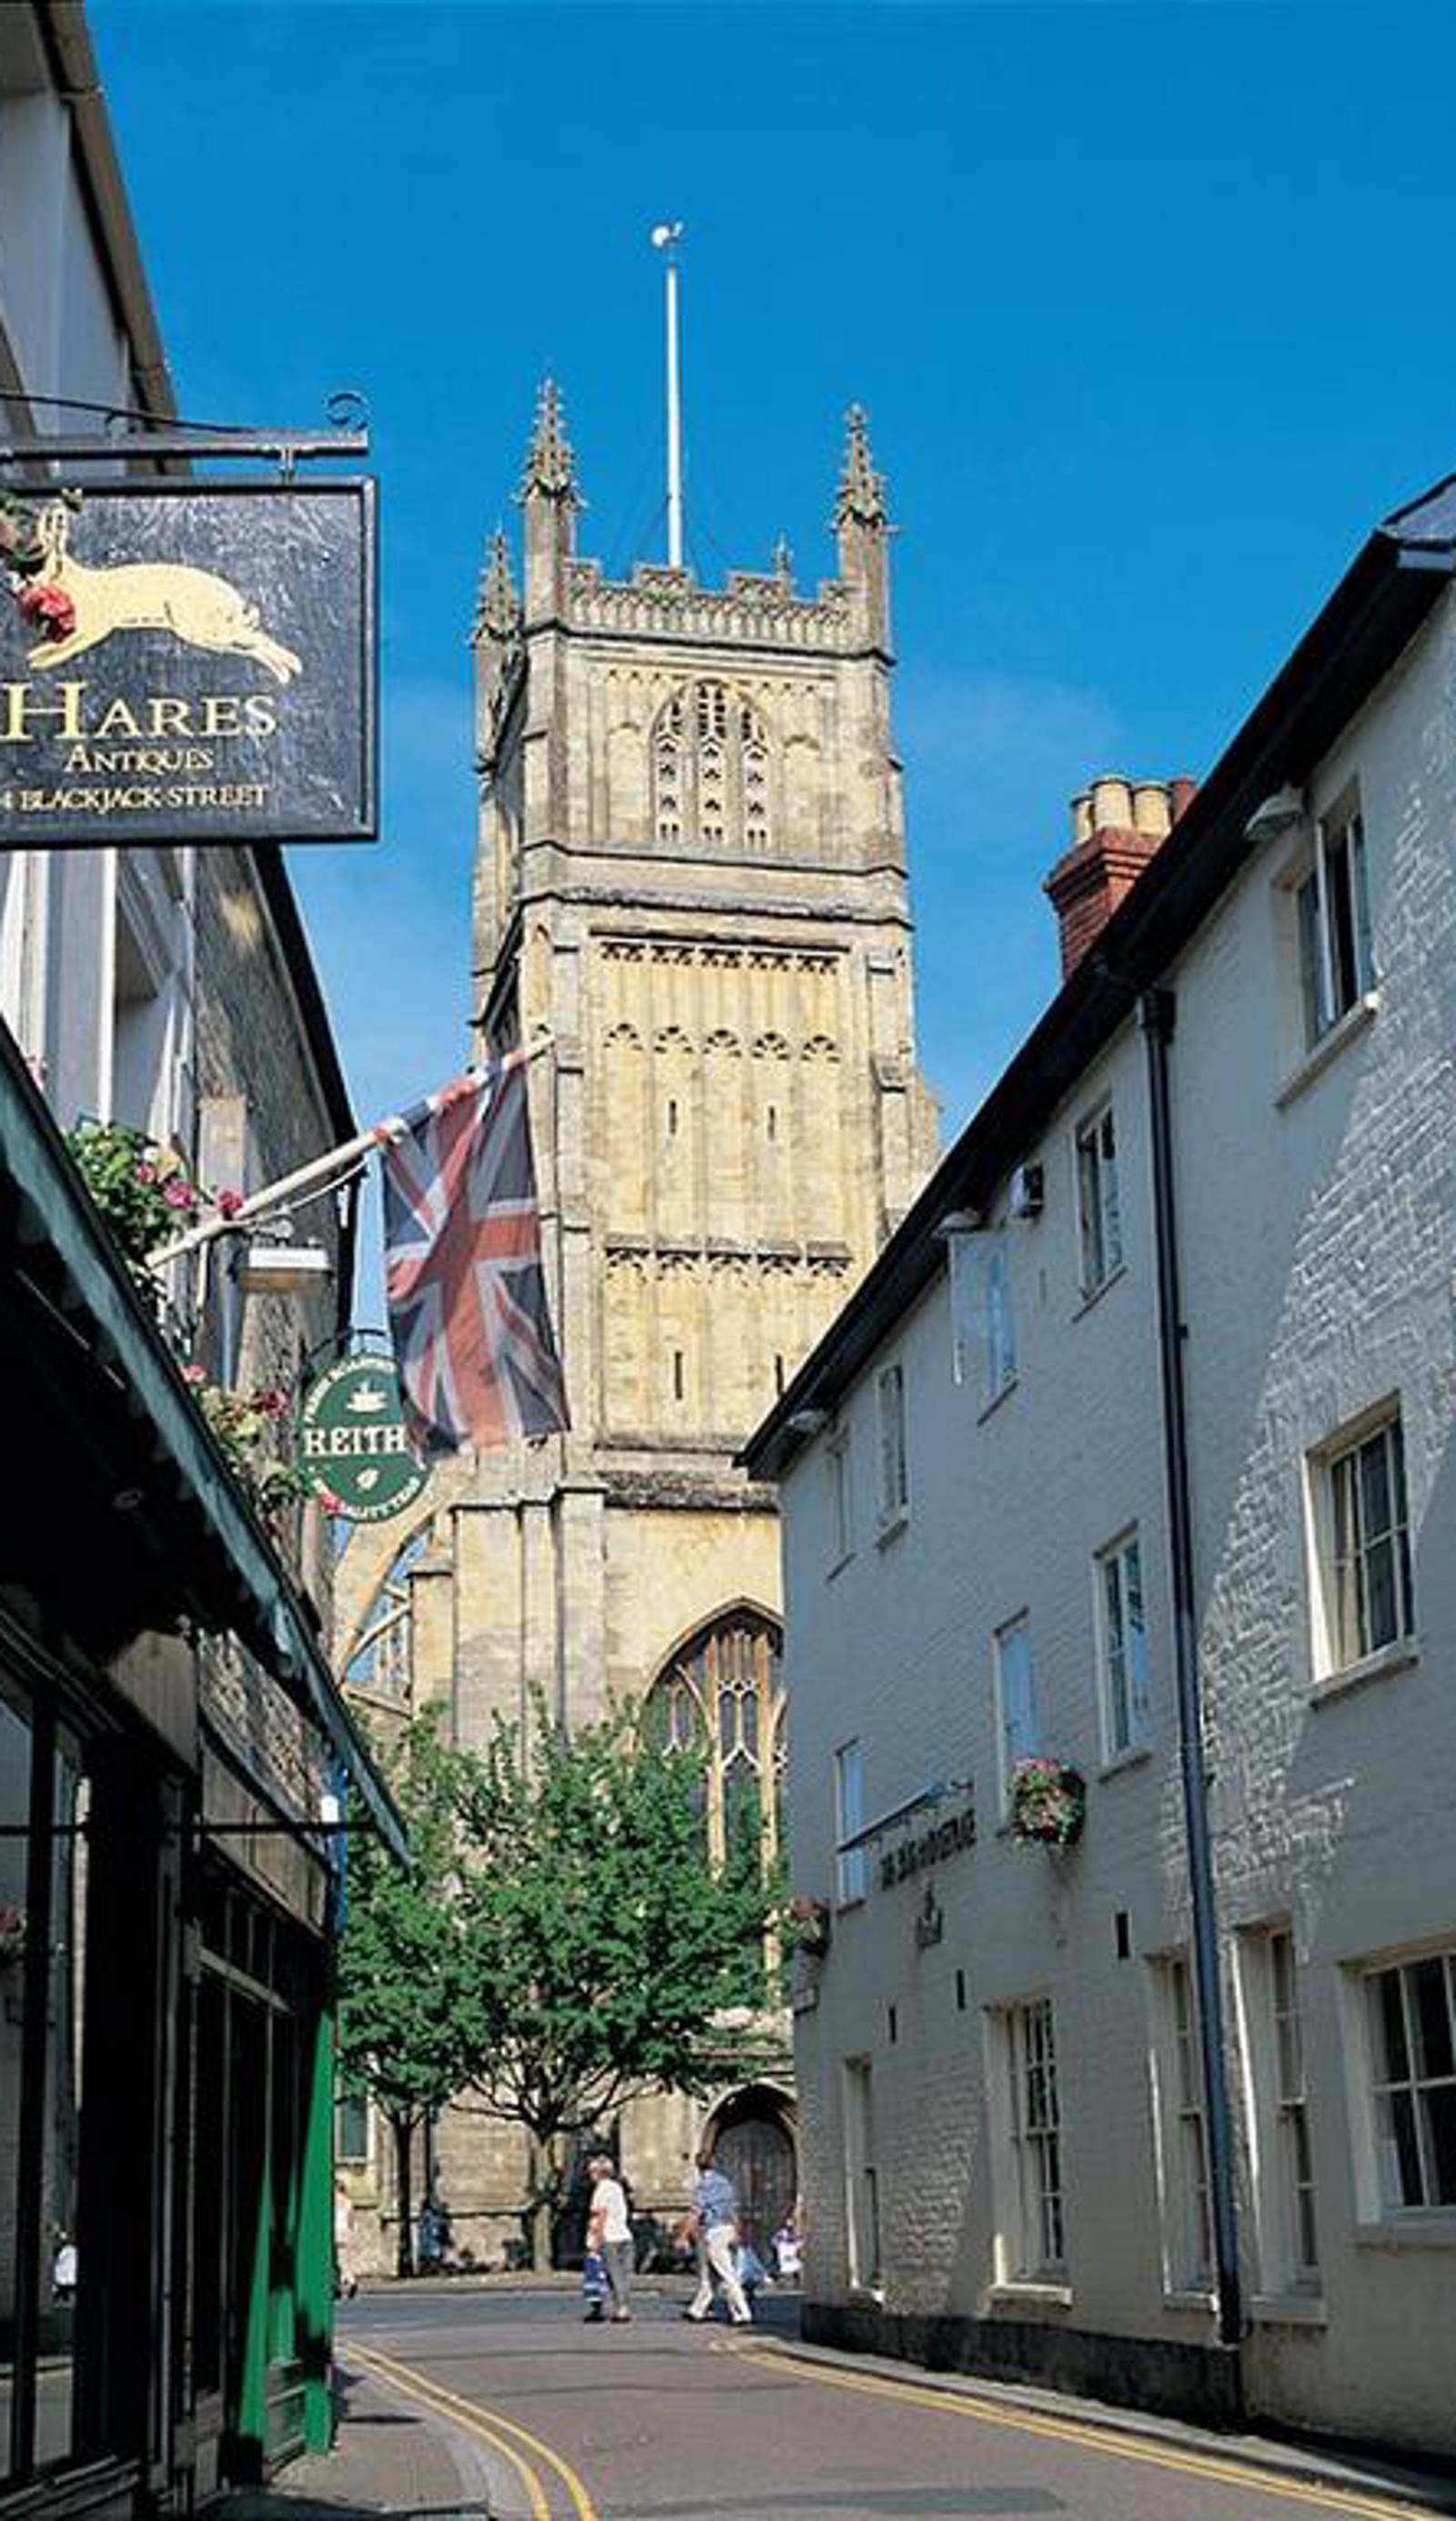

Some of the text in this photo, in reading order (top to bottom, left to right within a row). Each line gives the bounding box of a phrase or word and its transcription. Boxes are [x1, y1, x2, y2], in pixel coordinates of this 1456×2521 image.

[0, 682, 278, 740] HARES
[64, 744, 215, 775] ANTIQUES
[19, 787, 162, 815] BLACKJACK
[167, 785, 269, 808] STREET
